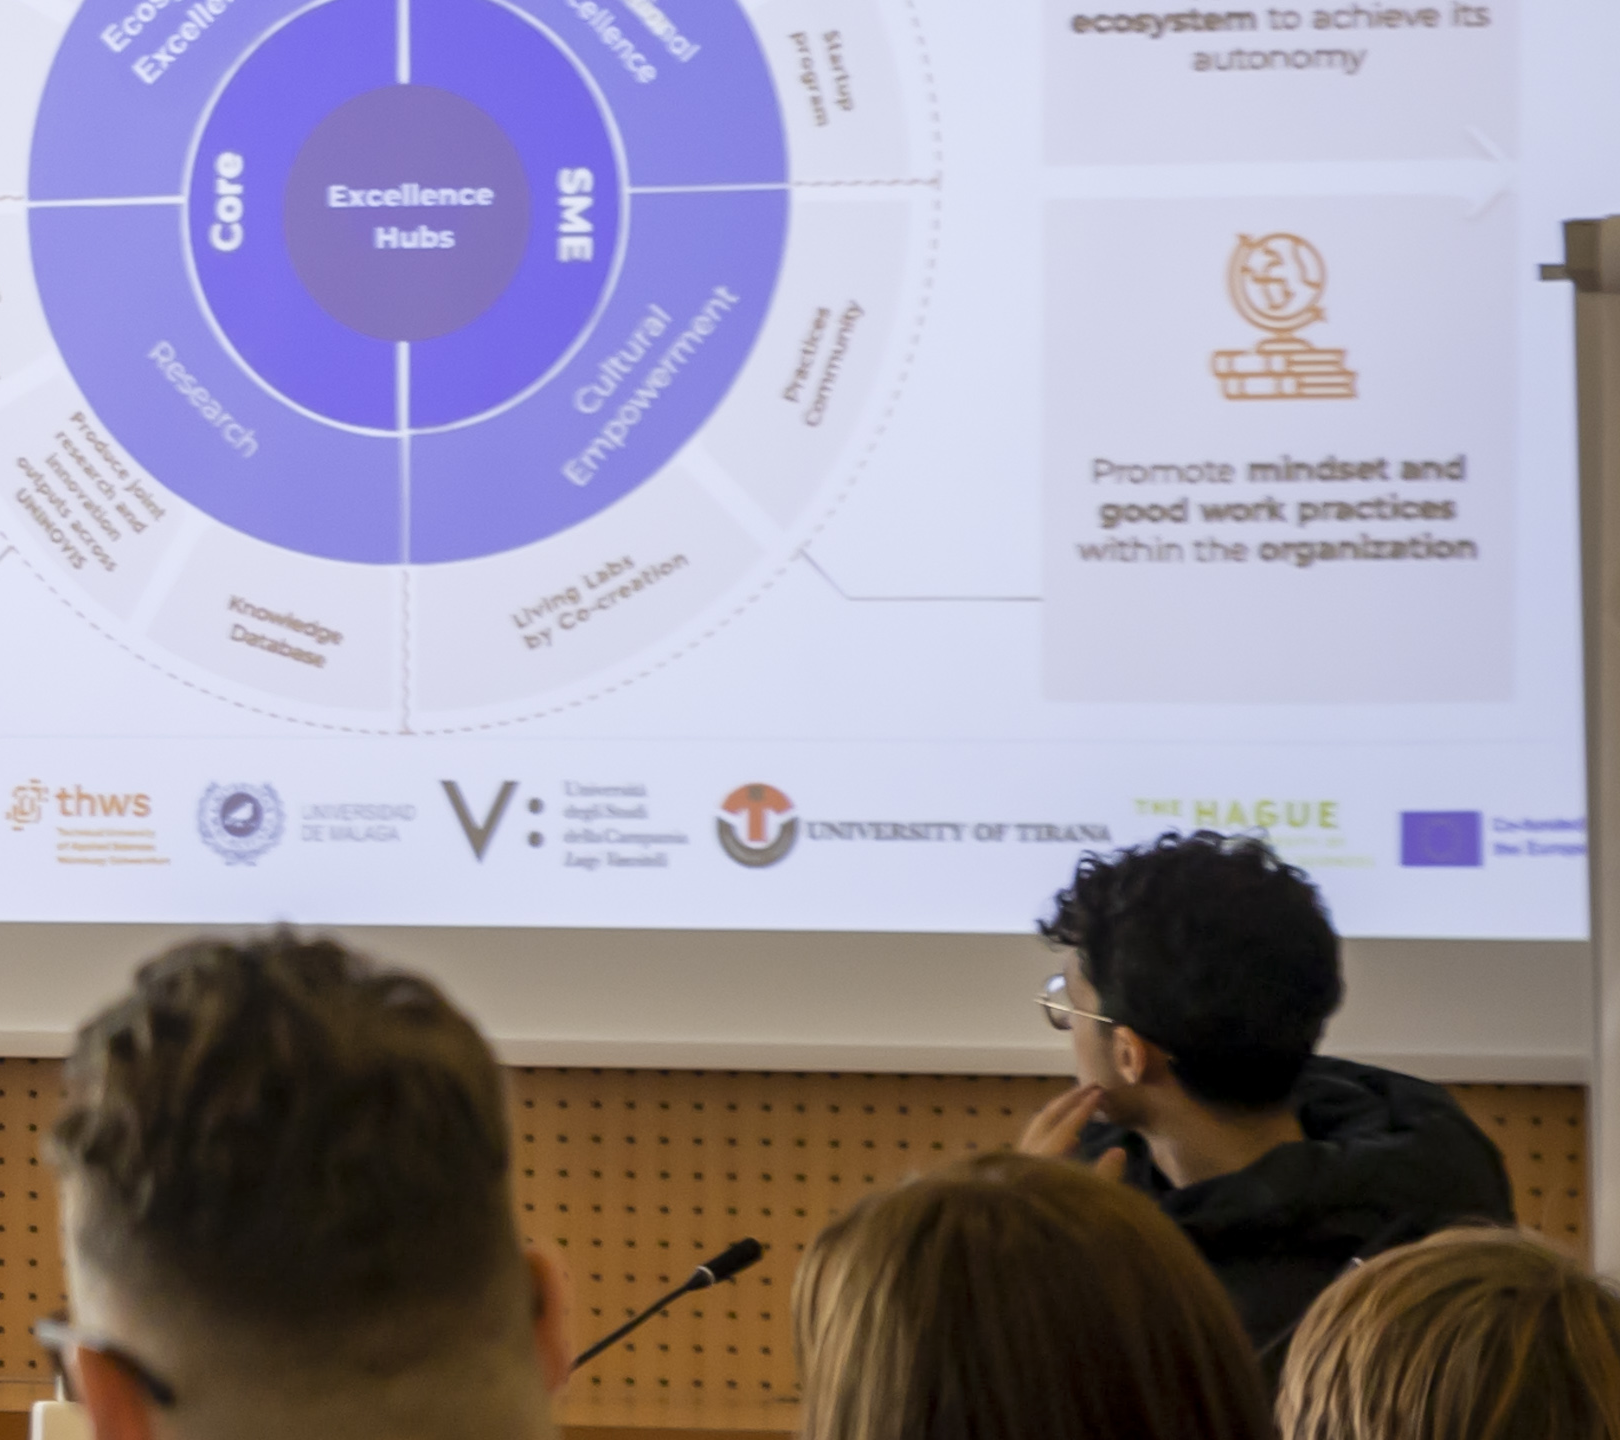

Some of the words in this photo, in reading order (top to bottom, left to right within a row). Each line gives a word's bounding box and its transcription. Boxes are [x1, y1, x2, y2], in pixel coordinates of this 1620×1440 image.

[1071, 9, 1257, 39] ecosystem
[1268, 7, 1301, 30] to
[1313, 3, 1440, 30] achieve
[1452, 1, 1491, 28] its
[1192, 48, 1367, 75] autonomy
[788, 31, 830, 127] program
[823, 29, 855, 112] Startup
[209, 151, 245, 252] Core
[326, 182, 495, 208] Excellence
[373, 225, 456, 249] Hubs
[556, 166, 594, 262] SME
[560, 284, 740, 487] Empowerment
[572, 303, 673, 415] Cultural
[782, 307, 831, 403] Practices
[803, 299, 865, 427] Community
[147, 340, 259, 459] Research
[45, 453, 121, 541] innovation
[55, 432, 116, 500] research
[116, 502, 148, 534] and
[70, 411, 130, 480] Produce
[124, 479, 166, 521] joint
[1092, 458, 1235, 485] Promote
[1247, 455, 1388, 482] mindset
[1399, 455, 1467, 482] and
[17, 457, 72, 518] outputs
[71, 520, 118, 572] across
[1076, 535, 1184, 564] within
[1193, 536, 1248, 561] the
[1258, 533, 1478, 568] organization
[1099, 498, 1189, 528] good
[1201, 496, 1286, 523] work
[1296, 492, 1457, 526] practices
[228, 595, 344, 645] Knowledge
[511, 587, 581, 629] Living
[582, 555, 635, 589] Labs
[523, 628, 553, 650] by
[558, 554, 689, 630] Co-creation
[55, 785, 151, 818] thws
[807, 821, 964, 842] UNIVERSITY
[974, 822, 1009, 842] OF
[1014, 822, 1112, 844] TIRANA
[1135, 799, 1181, 817] THE
[1194, 799, 1339, 829] HAGUE
